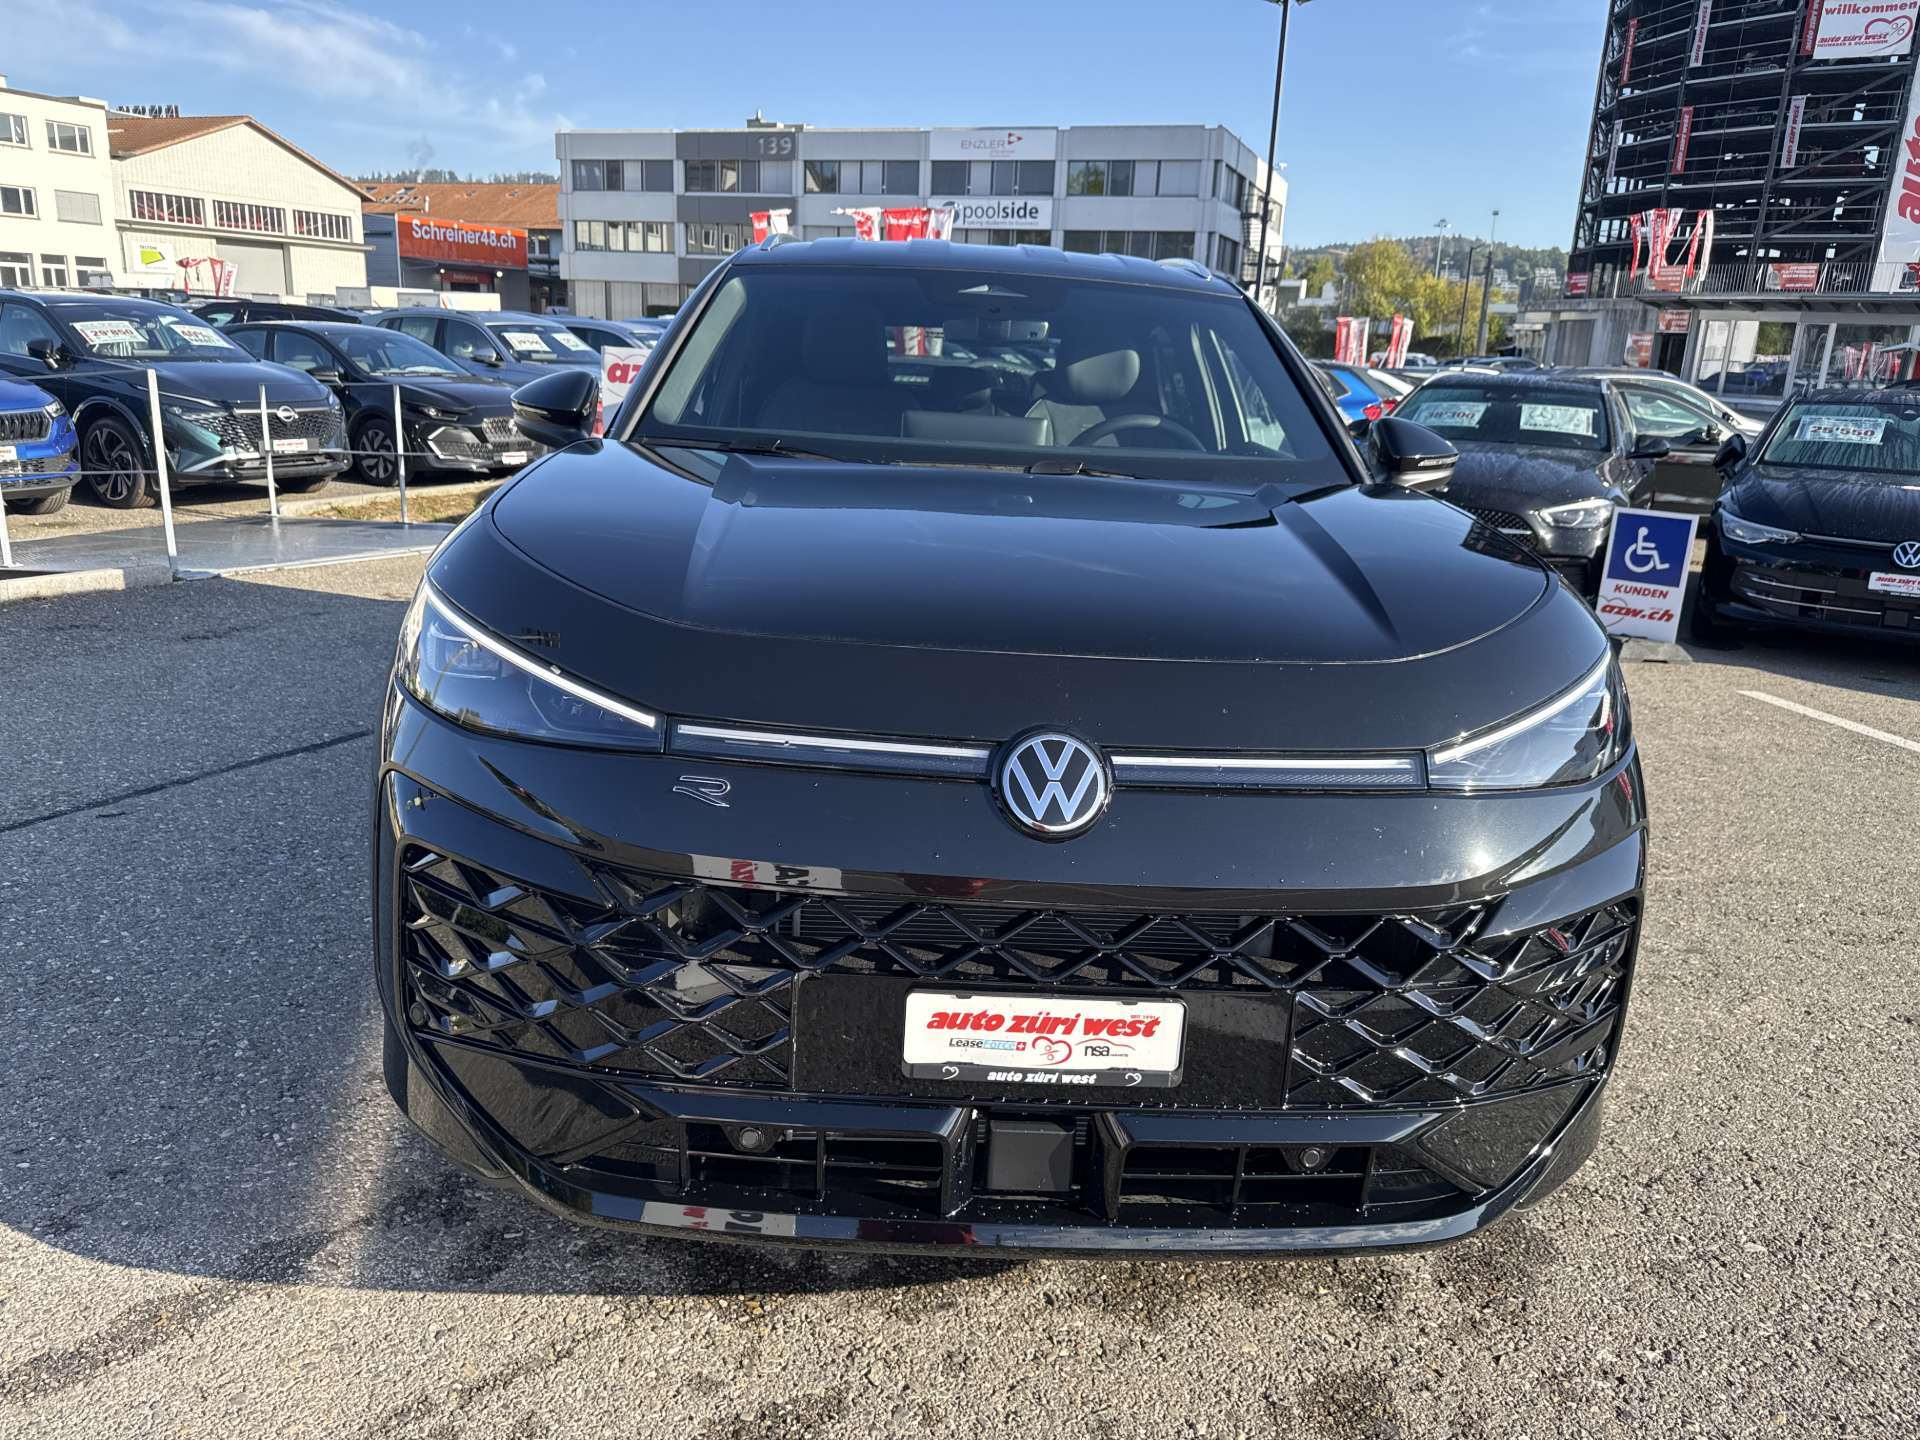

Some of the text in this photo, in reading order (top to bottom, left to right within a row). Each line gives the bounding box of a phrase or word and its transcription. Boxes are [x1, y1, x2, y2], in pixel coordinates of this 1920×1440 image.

[1824, 1, 1918, 15] willkommen
[758, 137, 792, 155] 139
[960, 139, 1005, 150] ENZLER
[963, 200, 1039, 225] poolside
[412, 219, 516, 249] Schreiner48.ch
[1809, 425, 1875, 437] 25'550
[1614, 583, 1670, 600] KUNDEN
[1601, 603, 1674, 623] azw.ch
[926, 1010, 1162, 1038] auto züri west
[1084, 1044, 1110, 1058] nsa
[987, 1070, 1097, 1085] auto züri west
